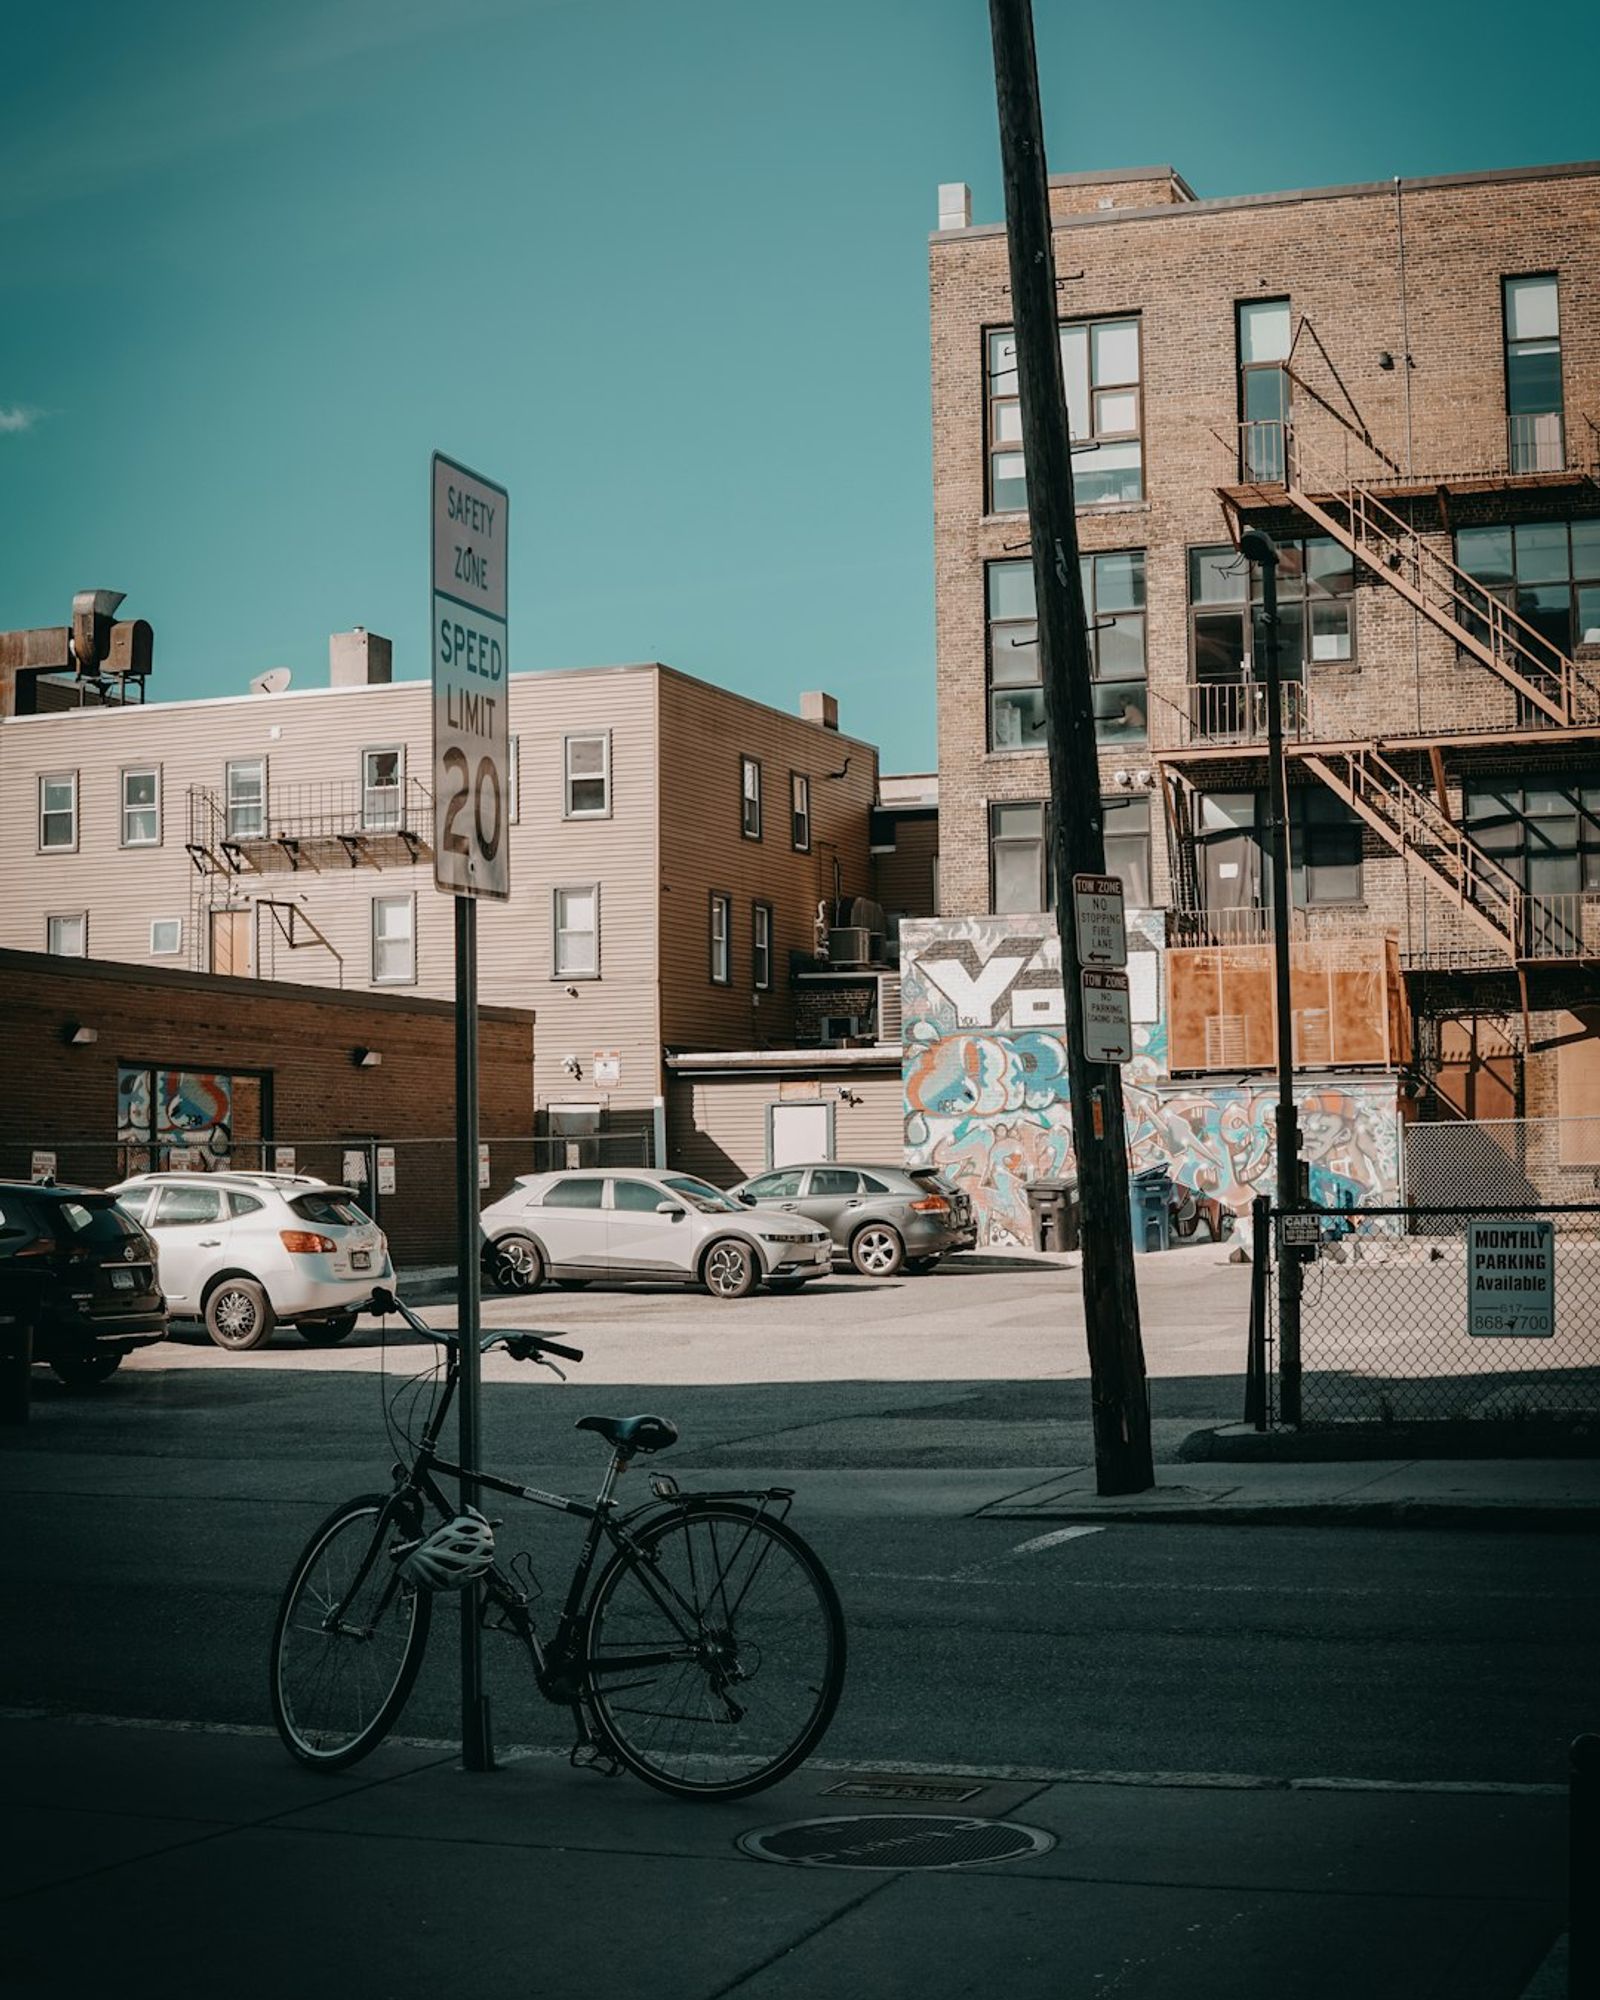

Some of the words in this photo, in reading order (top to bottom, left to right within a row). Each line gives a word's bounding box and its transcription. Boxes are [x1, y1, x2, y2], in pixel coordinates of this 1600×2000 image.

[447, 486, 495, 536] SAFETY
[454, 546, 488, 591] ZONE
[440, 618, 502, 682] SPEED
[447, 684, 496, 740] LIMIT
[442, 745, 501, 862] 20
[1077, 880, 1096, 892] TOW
[1098, 881, 1121, 893] ZONE
[1092, 897, 1107, 911] NO
[1081, 912, 1121, 924] STOPPING
[1092, 925, 1111, 937] FIRE
[1092, 938, 1113, 950] LANE
[1084, 973, 1102, 987] TOW
[1104, 974, 1128, 989] ZONE
[1101, 992, 1112, 1002] NO
[1091, 1003, 1123, 1014] PARKING
[1475, 1230, 1545, 1250] MONTHLY
[1475, 1254, 1546, 1271] PARKING
[1475, 1275, 1547, 1292] Available
[1499, 1303, 1523, 1314] 617
